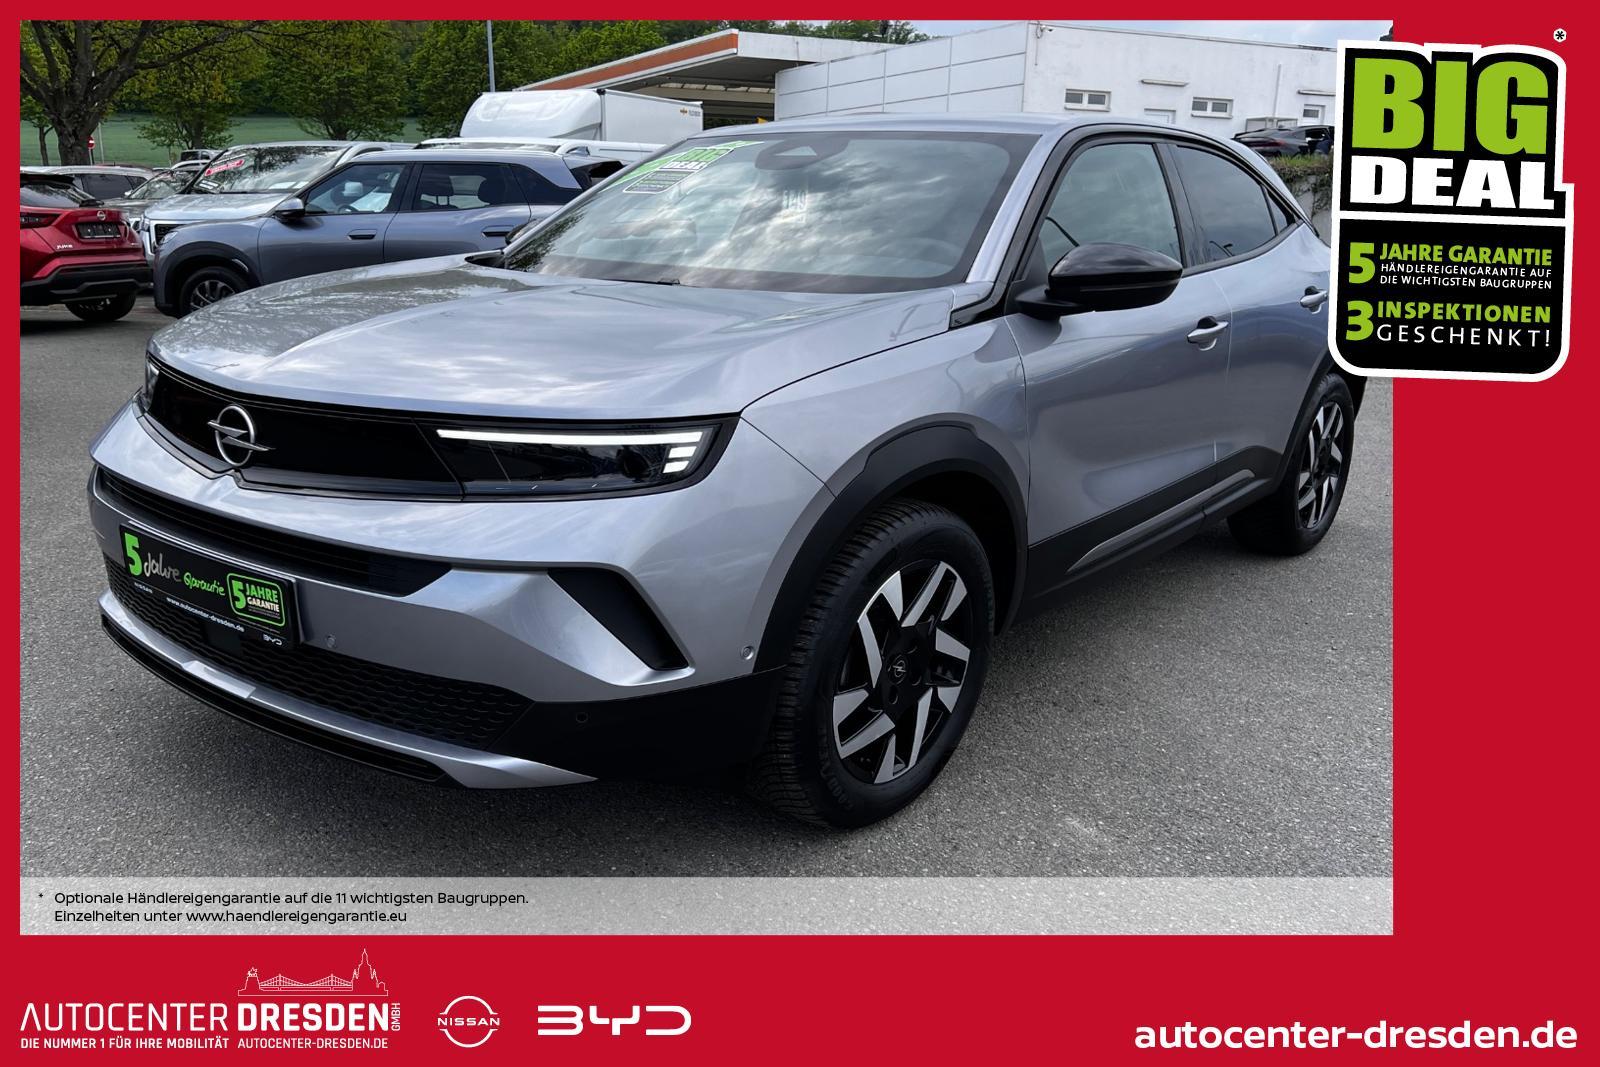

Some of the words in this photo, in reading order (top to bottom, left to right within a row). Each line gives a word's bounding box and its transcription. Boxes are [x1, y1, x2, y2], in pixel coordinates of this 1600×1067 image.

[124, 532, 143, 576] 5
[231, 579, 247, 610] 5
[245, 583, 279, 604] JAHRE
[246, 596, 280, 613] GARANTIE
